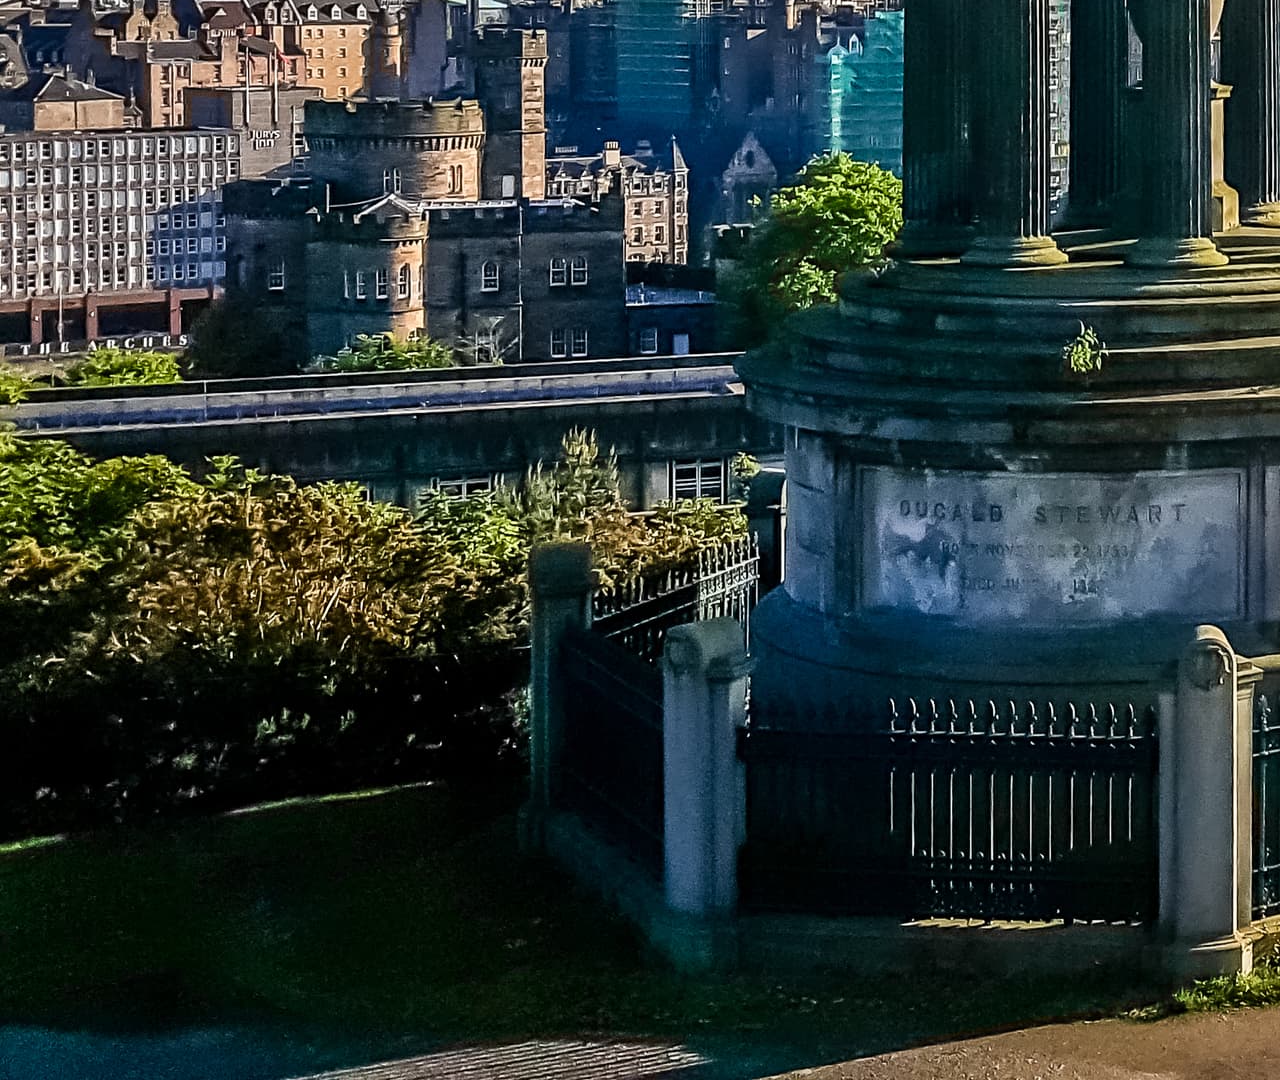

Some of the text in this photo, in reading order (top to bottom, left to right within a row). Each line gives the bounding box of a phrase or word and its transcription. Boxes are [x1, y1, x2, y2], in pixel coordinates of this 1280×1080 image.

[250, 130, 280, 141] JURYS
[20, 334, 188, 356] THE ARCHES
[1034, 503, 1187, 523] STEWART
